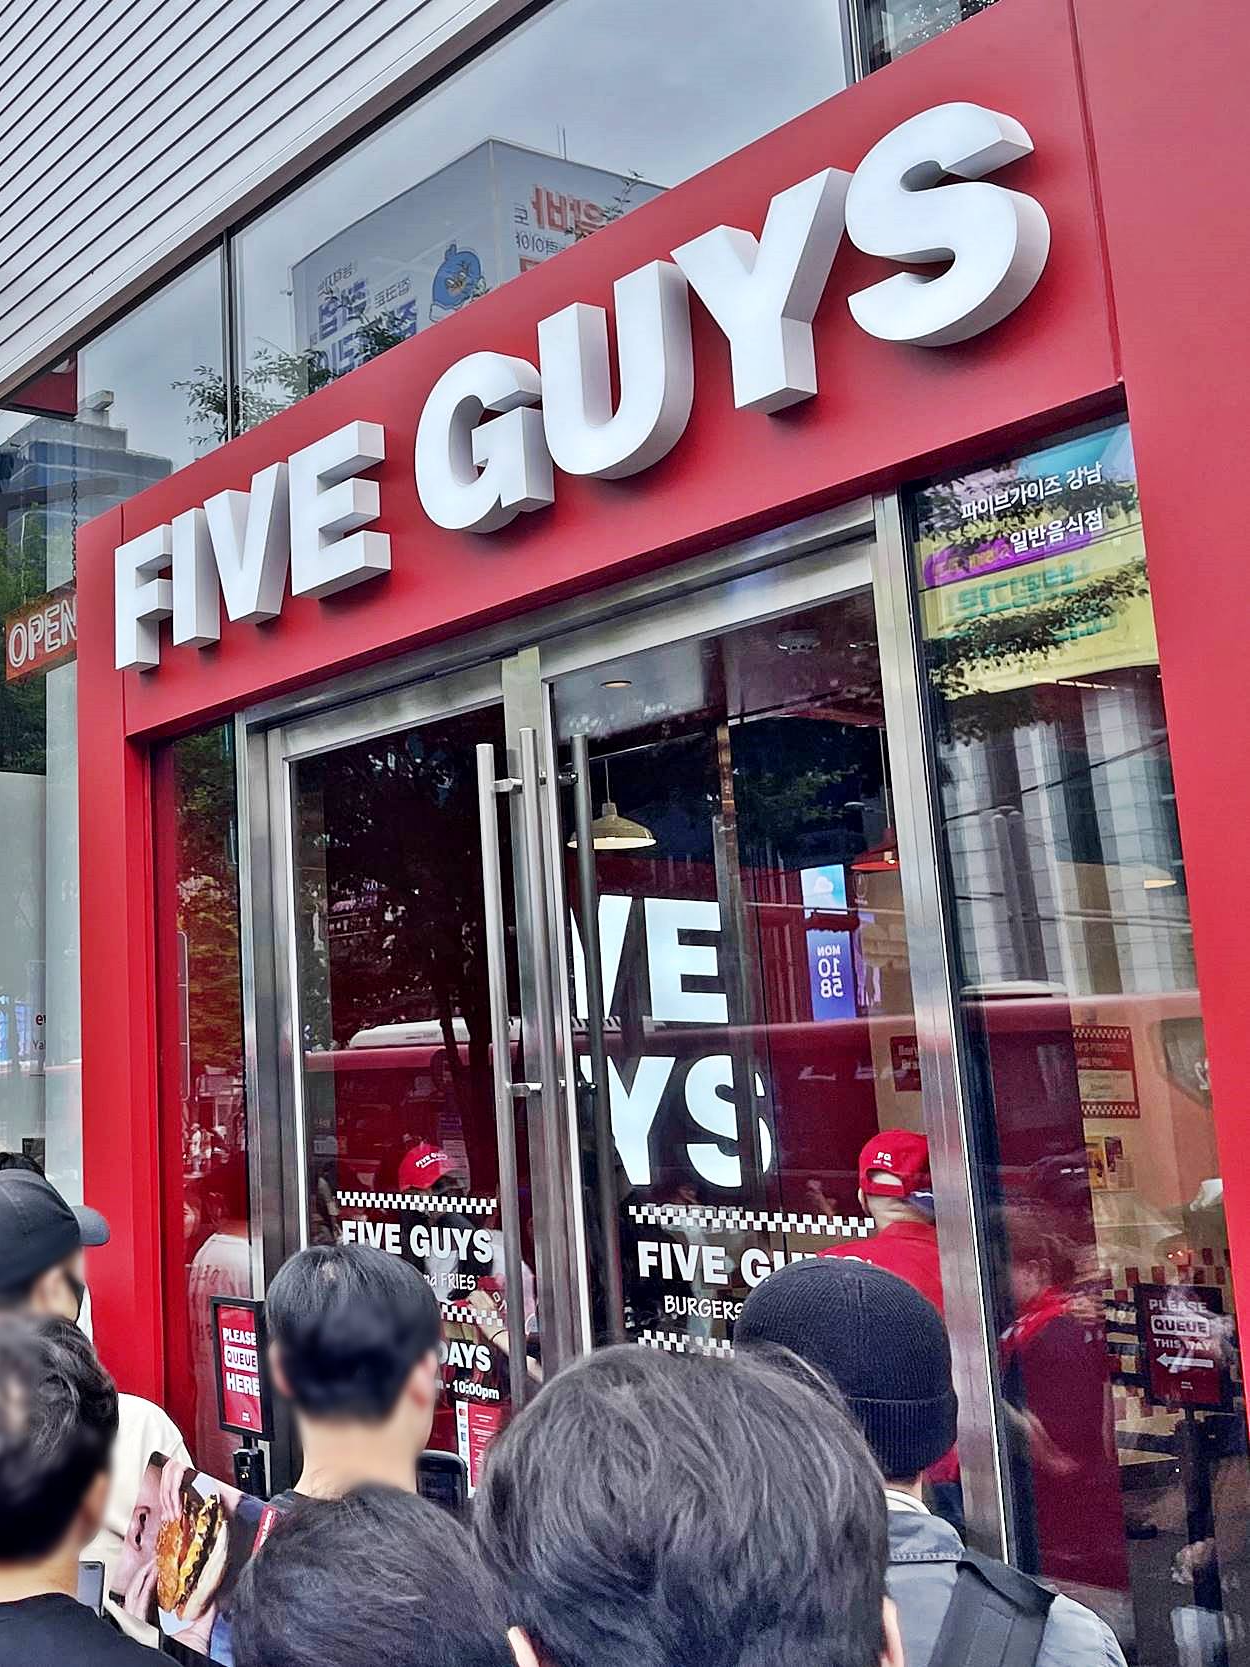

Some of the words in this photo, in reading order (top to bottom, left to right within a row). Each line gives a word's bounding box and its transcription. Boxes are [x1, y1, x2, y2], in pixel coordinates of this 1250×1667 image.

[114, 419, 392, 672] FIVE
[414, 101, 1051, 534] GUYS
[961, 475, 1063, 521] 파이브가이즈
[1066, 461, 1103, 491] 강남
[1009, 507, 1104, 554] 일반음식점
[8, 594, 78, 668] OPEN
[570, 894, 729, 1024] VE
[579, 1054, 772, 1188] YS
[341, 1220, 402, 1255] FIVE
[409, 1224, 493, 1263] GUYS
[637, 1240, 729, 1285] FIVE
[441, 1274, 476, 1291] FRIES
[664, 1295, 743, 1320] BURGERS
[1149, 1299, 1208, 1313] PLEASE
[222, 1327, 258, 1346] PLEASE
[1153, 1318, 1208, 1333] QUEUE
[1153, 1337, 1181, 1349] THIS
[1184, 1340, 1213, 1351] WAY
[226, 1350, 257, 1368] QUEUE
[225, 1371, 262, 1398] HERE
[453, 1379, 500, 1400] 10:00pm
